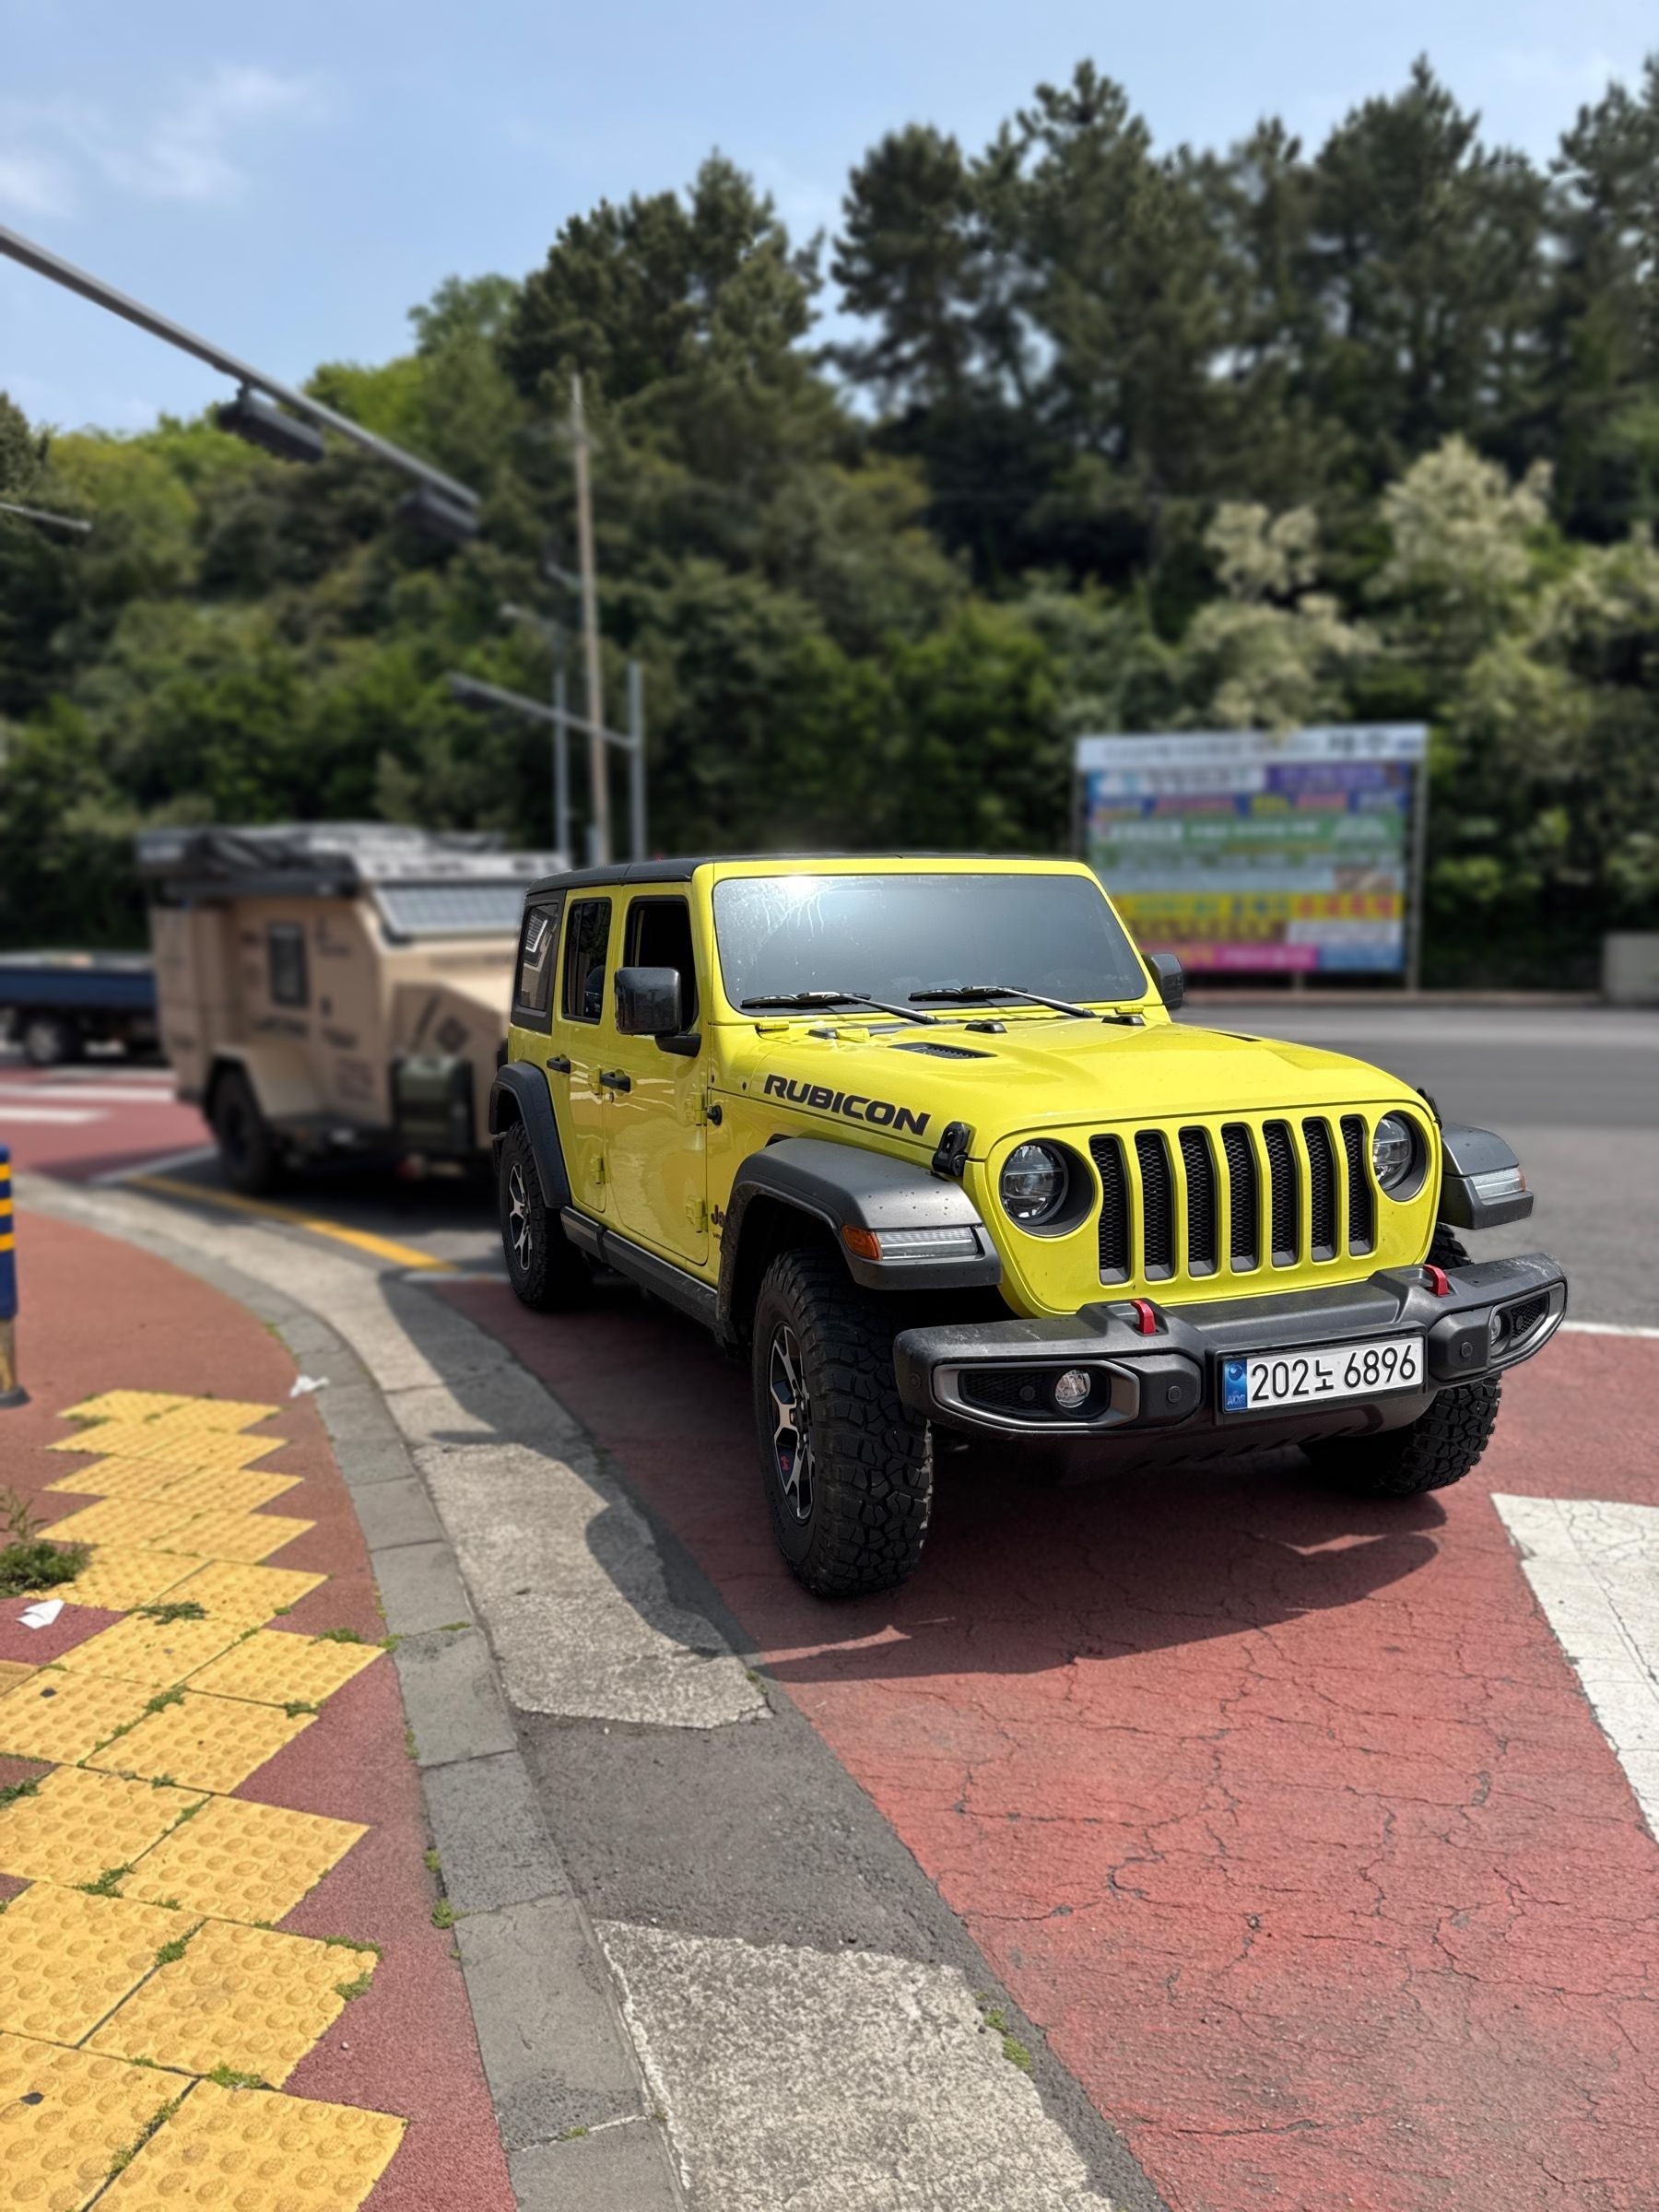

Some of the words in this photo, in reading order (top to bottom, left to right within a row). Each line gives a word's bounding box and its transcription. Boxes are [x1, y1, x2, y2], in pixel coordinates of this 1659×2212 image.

[764, 1074, 932, 1136] RUBICON
[1252, 1359, 1335, 1402] 202노
[1344, 1344, 1417, 1389] 6896
